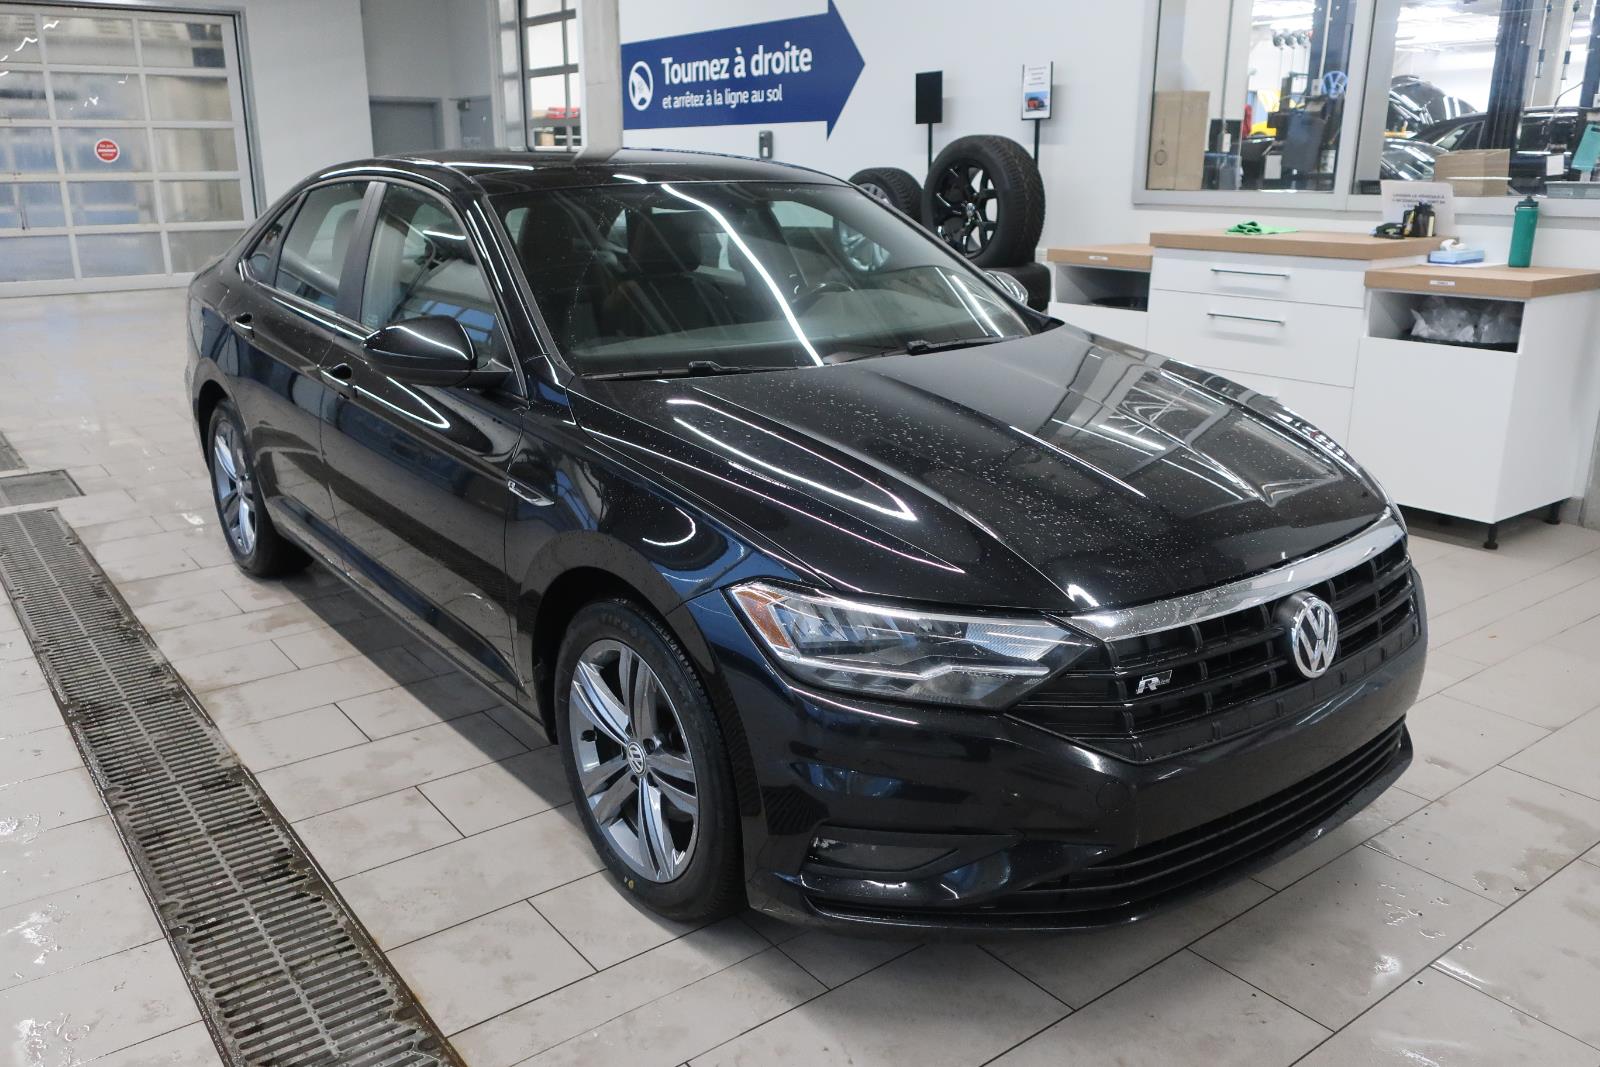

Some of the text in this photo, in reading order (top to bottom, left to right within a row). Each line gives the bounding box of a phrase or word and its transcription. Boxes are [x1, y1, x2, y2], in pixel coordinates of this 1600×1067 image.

[661, 40, 812, 85] Tournez à droite
[662, 83, 783, 109] et arrêtez à la ligne au sol
